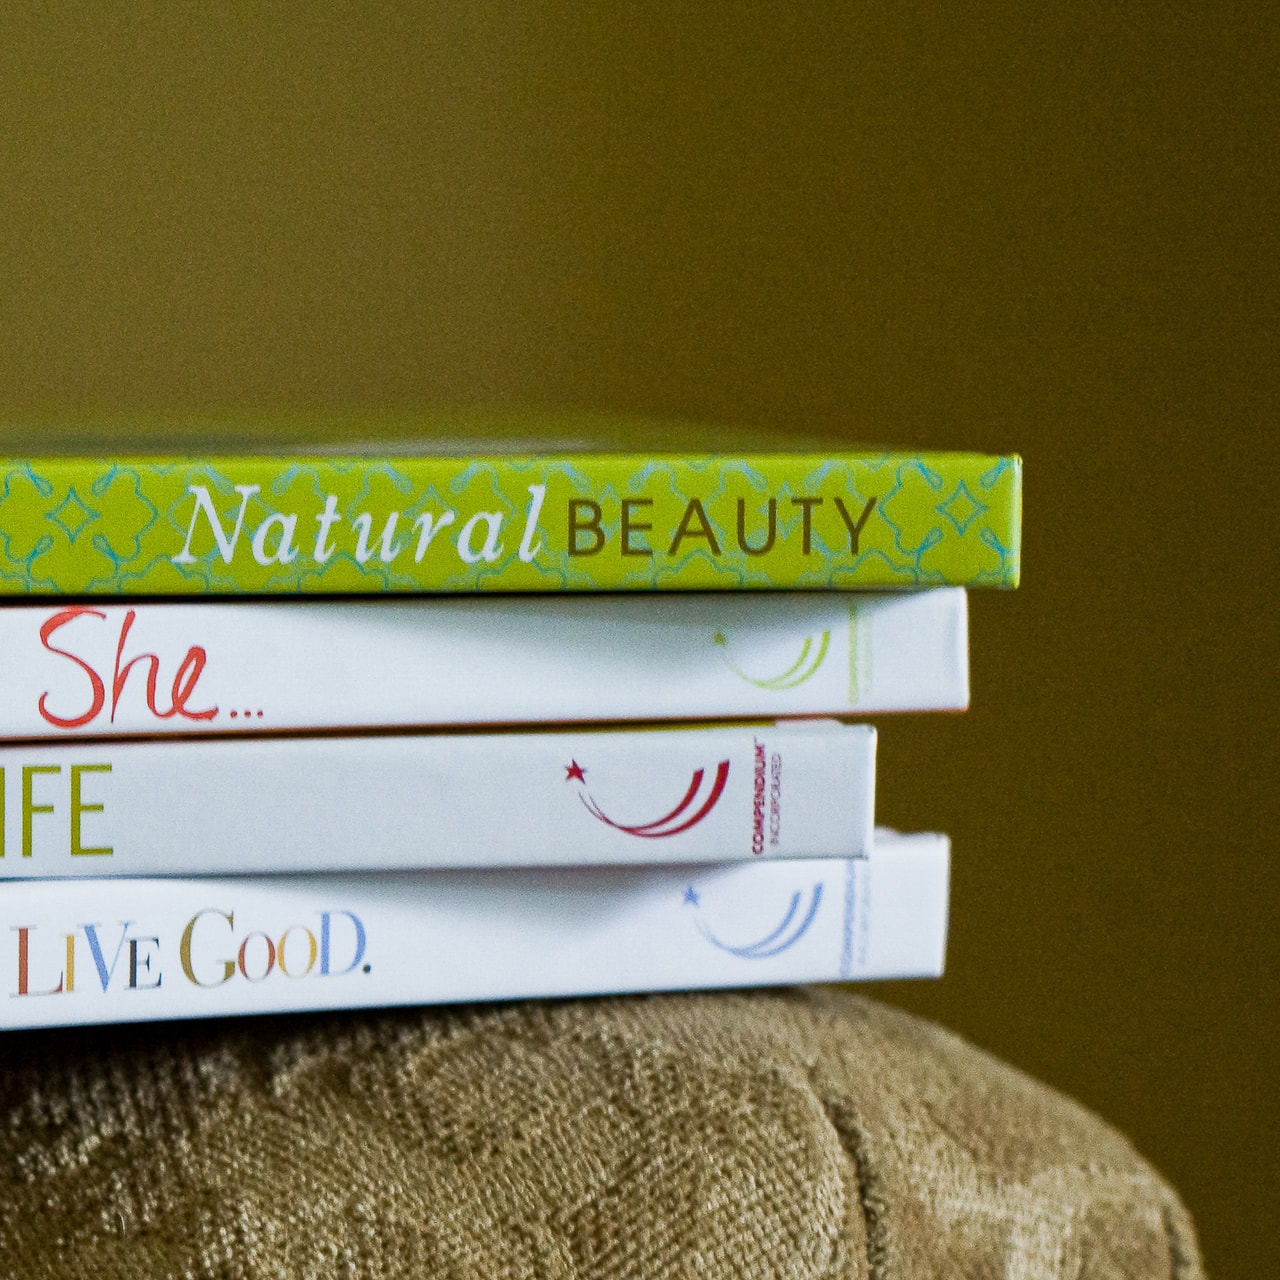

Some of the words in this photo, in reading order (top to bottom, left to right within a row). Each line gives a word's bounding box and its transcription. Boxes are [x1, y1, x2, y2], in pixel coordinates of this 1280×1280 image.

[170, 483, 548, 567] Natural
[566, 494, 879, 560] BEAUTY
[751, 744, 766, 856] COMPENDIUM
